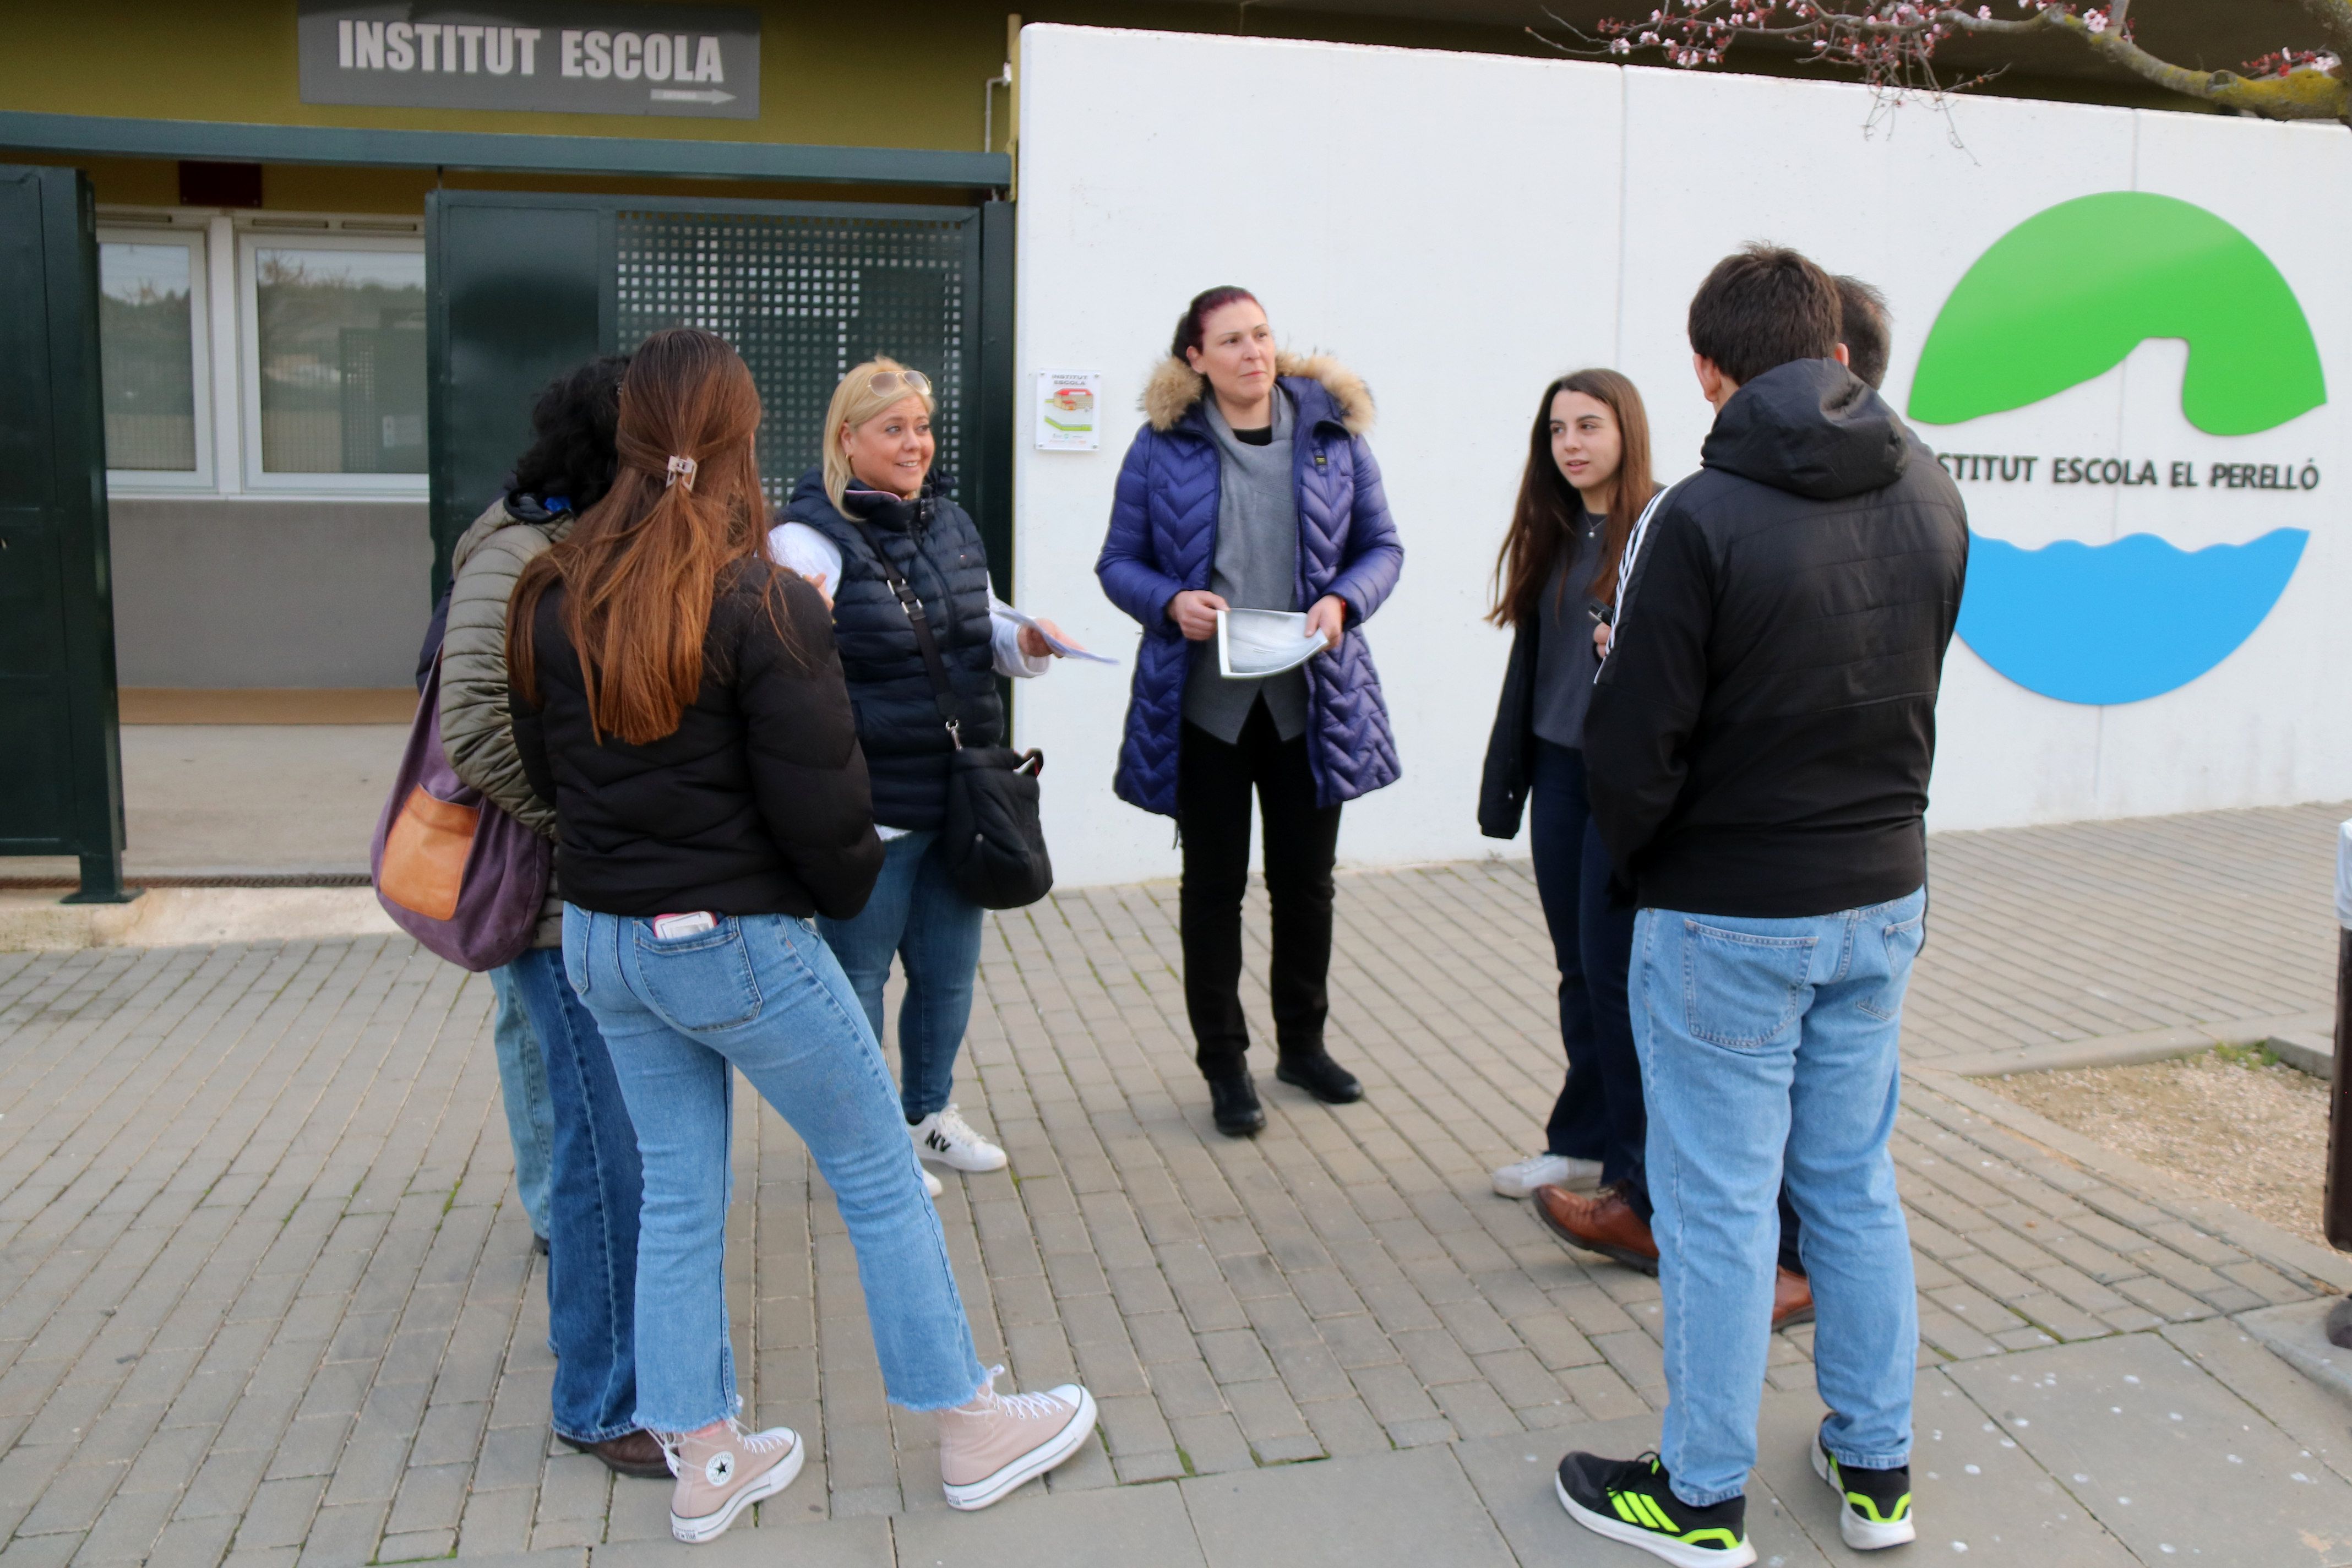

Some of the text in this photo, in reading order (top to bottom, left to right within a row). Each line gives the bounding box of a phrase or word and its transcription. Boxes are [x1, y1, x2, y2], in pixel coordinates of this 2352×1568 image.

[339, 19, 724, 83] INSTITUT ESCOLA
[1937, 452, 2319, 489] STITUT ESCOLA EL PERELLÓ
